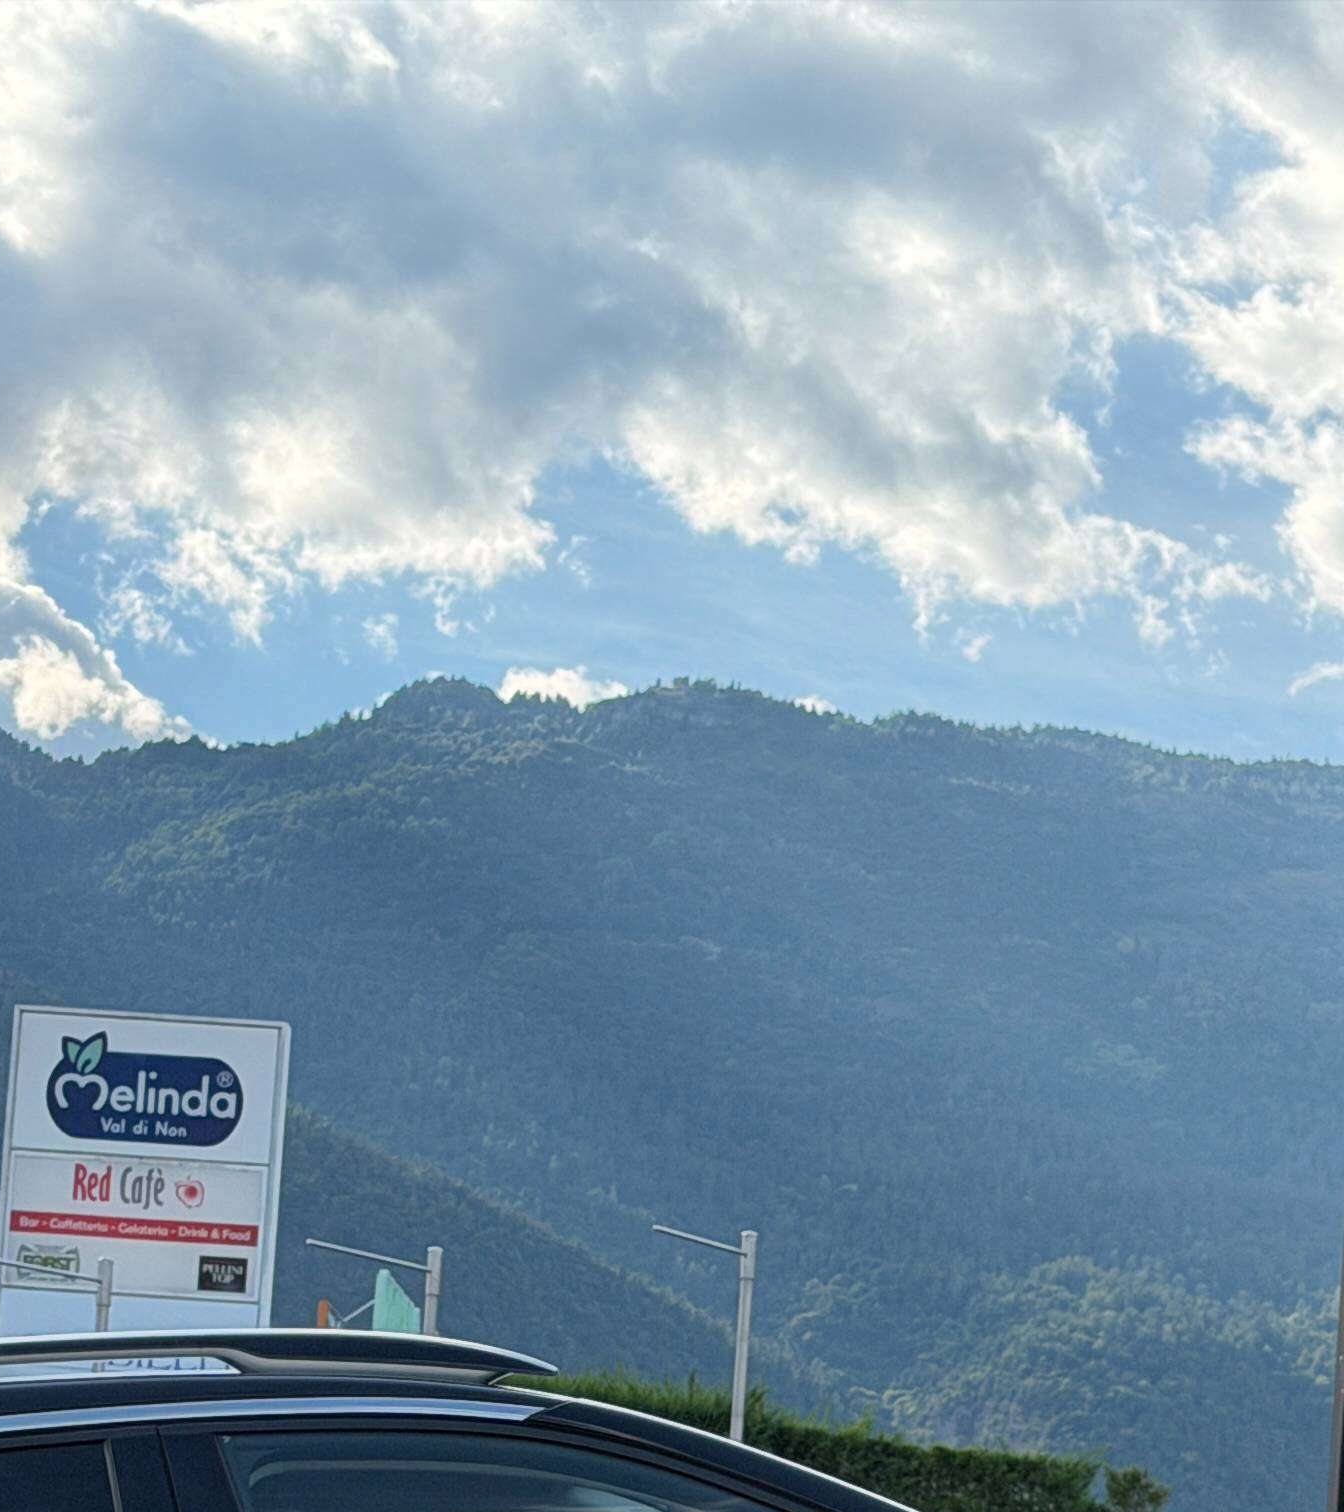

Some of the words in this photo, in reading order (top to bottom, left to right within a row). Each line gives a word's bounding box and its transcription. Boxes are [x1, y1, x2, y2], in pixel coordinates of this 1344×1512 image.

[55, 1070, 237, 1119] Melinda
[100, 1117, 126, 1134] Val
[132, 1120, 148, 1136] di
[155, 1121, 187, 1138] Non
[72, 1163, 112, 1202] Red
[19, 1216, 39, 1228] Bar
[118, 1222, 168, 1236] Gelateria
[178, 1226, 208, 1238] Drink
[222, 1229, 251, 1241] Food
